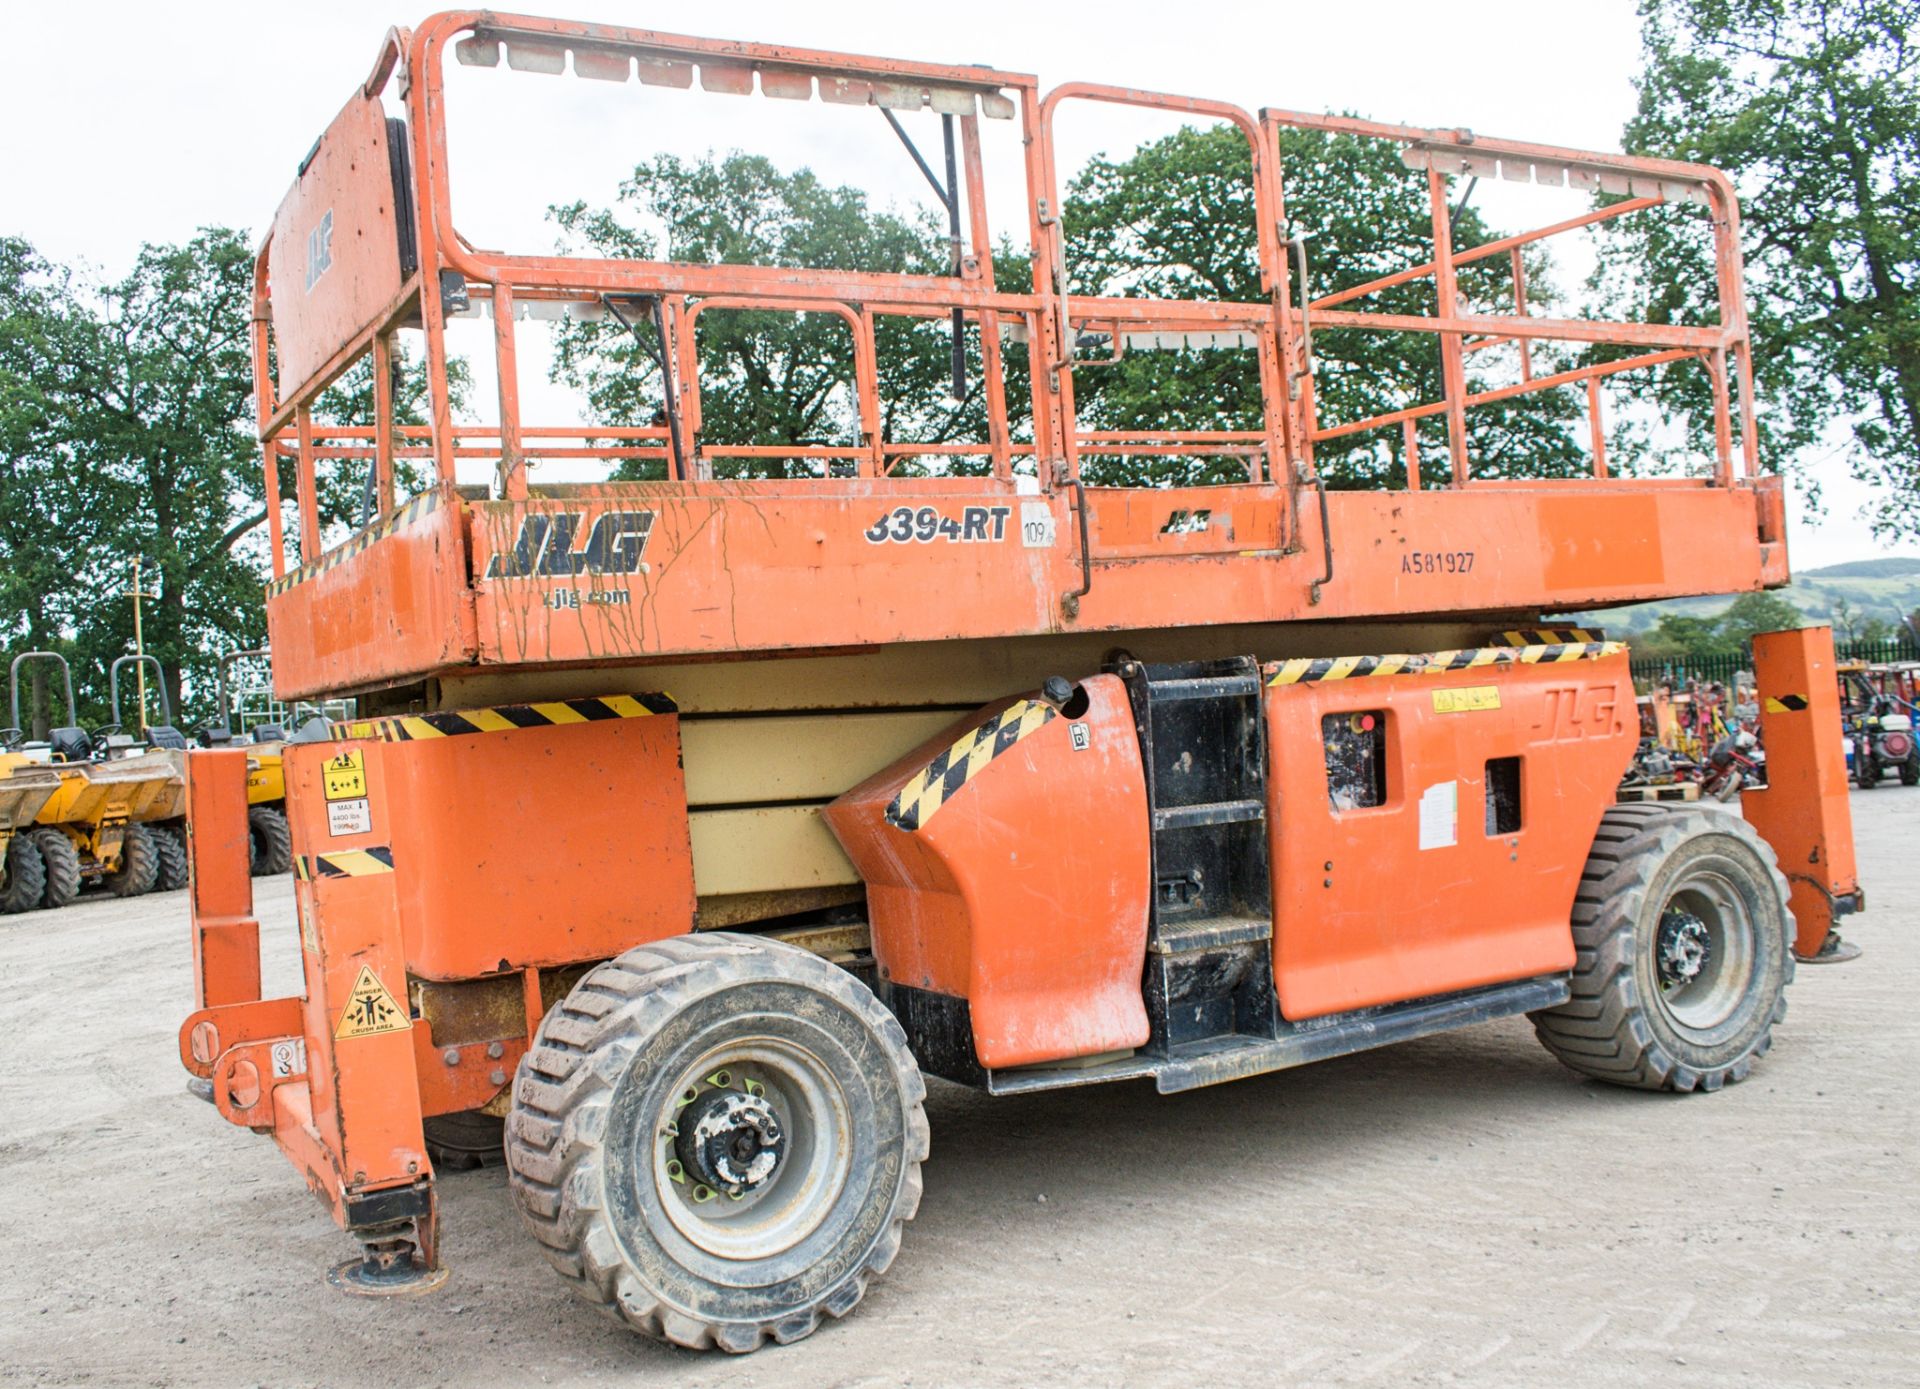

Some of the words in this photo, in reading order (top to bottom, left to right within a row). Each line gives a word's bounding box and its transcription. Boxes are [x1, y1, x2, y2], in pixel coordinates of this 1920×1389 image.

[484, 510, 659, 581] JLG
[1402, 553, 1475, 574] A581927
[1529, 685, 1617, 746] JLG
[354, 988, 382, 996] DANGER
